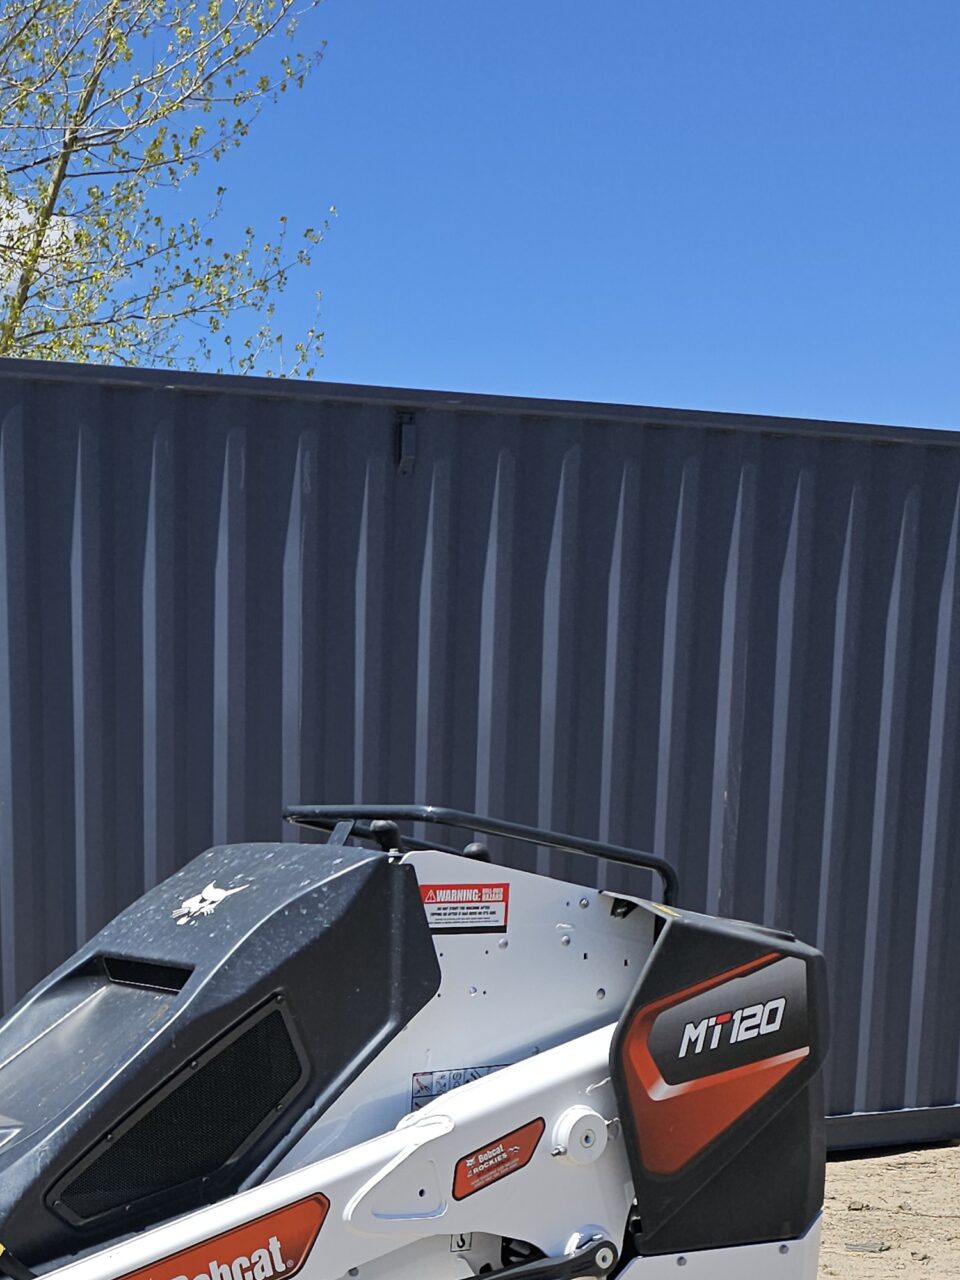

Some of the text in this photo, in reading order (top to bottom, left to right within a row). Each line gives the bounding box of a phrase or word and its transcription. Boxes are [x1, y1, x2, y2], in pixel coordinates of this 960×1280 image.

[436, 888, 481, 902] WARNING:
[679, 998, 785, 1058] MT120
[473, 1153, 507, 1174] ROCKIES
[478, 1144, 504, 1163] Bobcat
